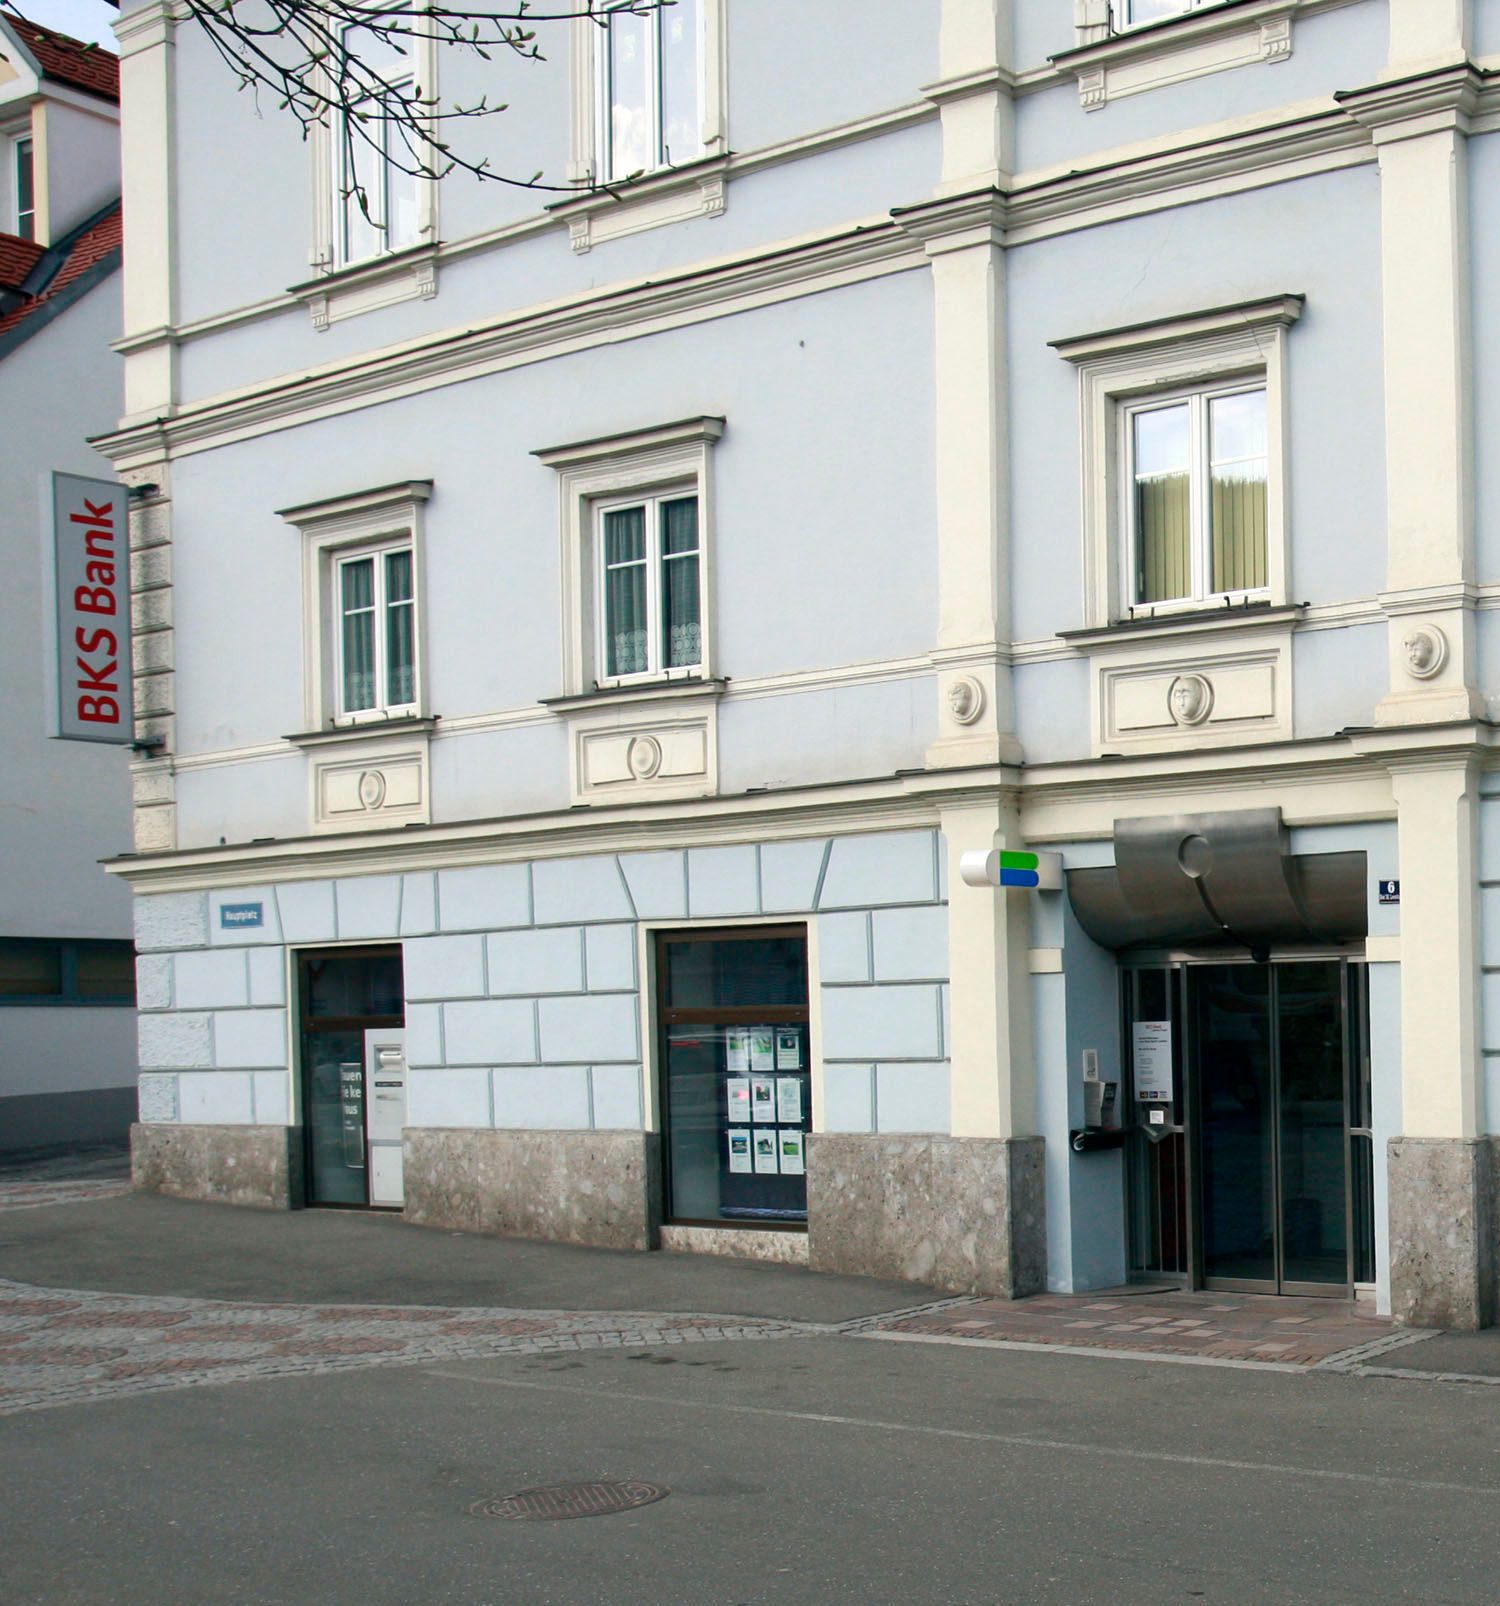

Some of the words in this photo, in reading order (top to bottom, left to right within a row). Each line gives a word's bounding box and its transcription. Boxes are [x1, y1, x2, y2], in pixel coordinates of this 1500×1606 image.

[69, 497, 116, 616] Bank
[75, 626, 119, 724] BKS
[1387, 881, 1396, 894] 6
